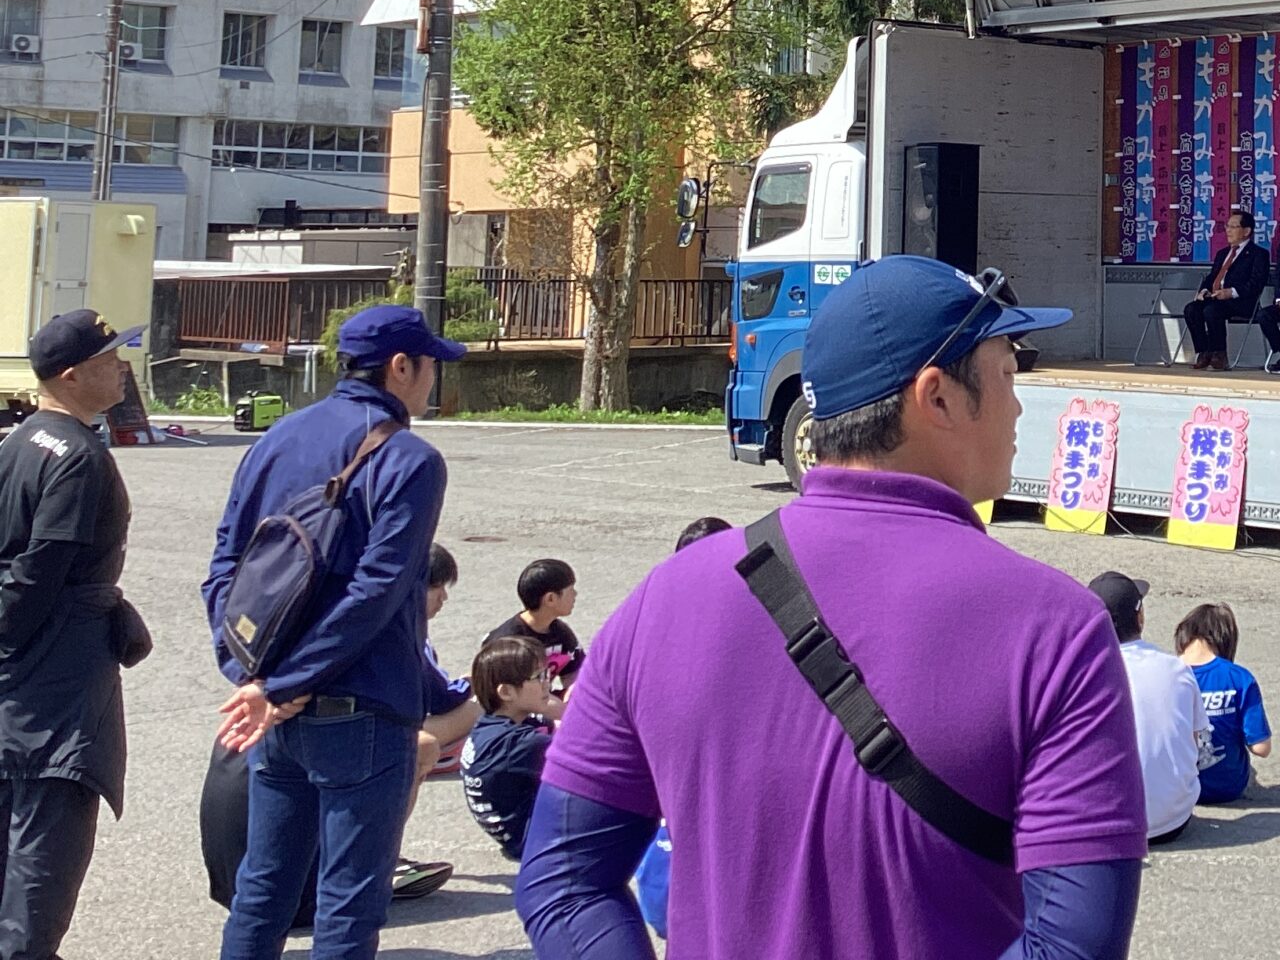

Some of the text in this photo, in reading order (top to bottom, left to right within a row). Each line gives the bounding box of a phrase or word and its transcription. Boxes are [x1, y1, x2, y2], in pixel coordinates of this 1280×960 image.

[1158, 46, 1171, 101] 山形県
[1216, 41, 1230, 98] 山形県
[1135, 57, 1159, 243] もがみ南部
[1193, 52, 1217, 242] もがみ南部
[1253, 48, 1279, 244] もがみ南部
[1060, 420, 1091, 509] 桜まつり
[1086, 422, 1105, 479] もがみ
[1185, 428, 1218, 522] 桜まつり
[1214, 429, 1233, 491] もがみ
